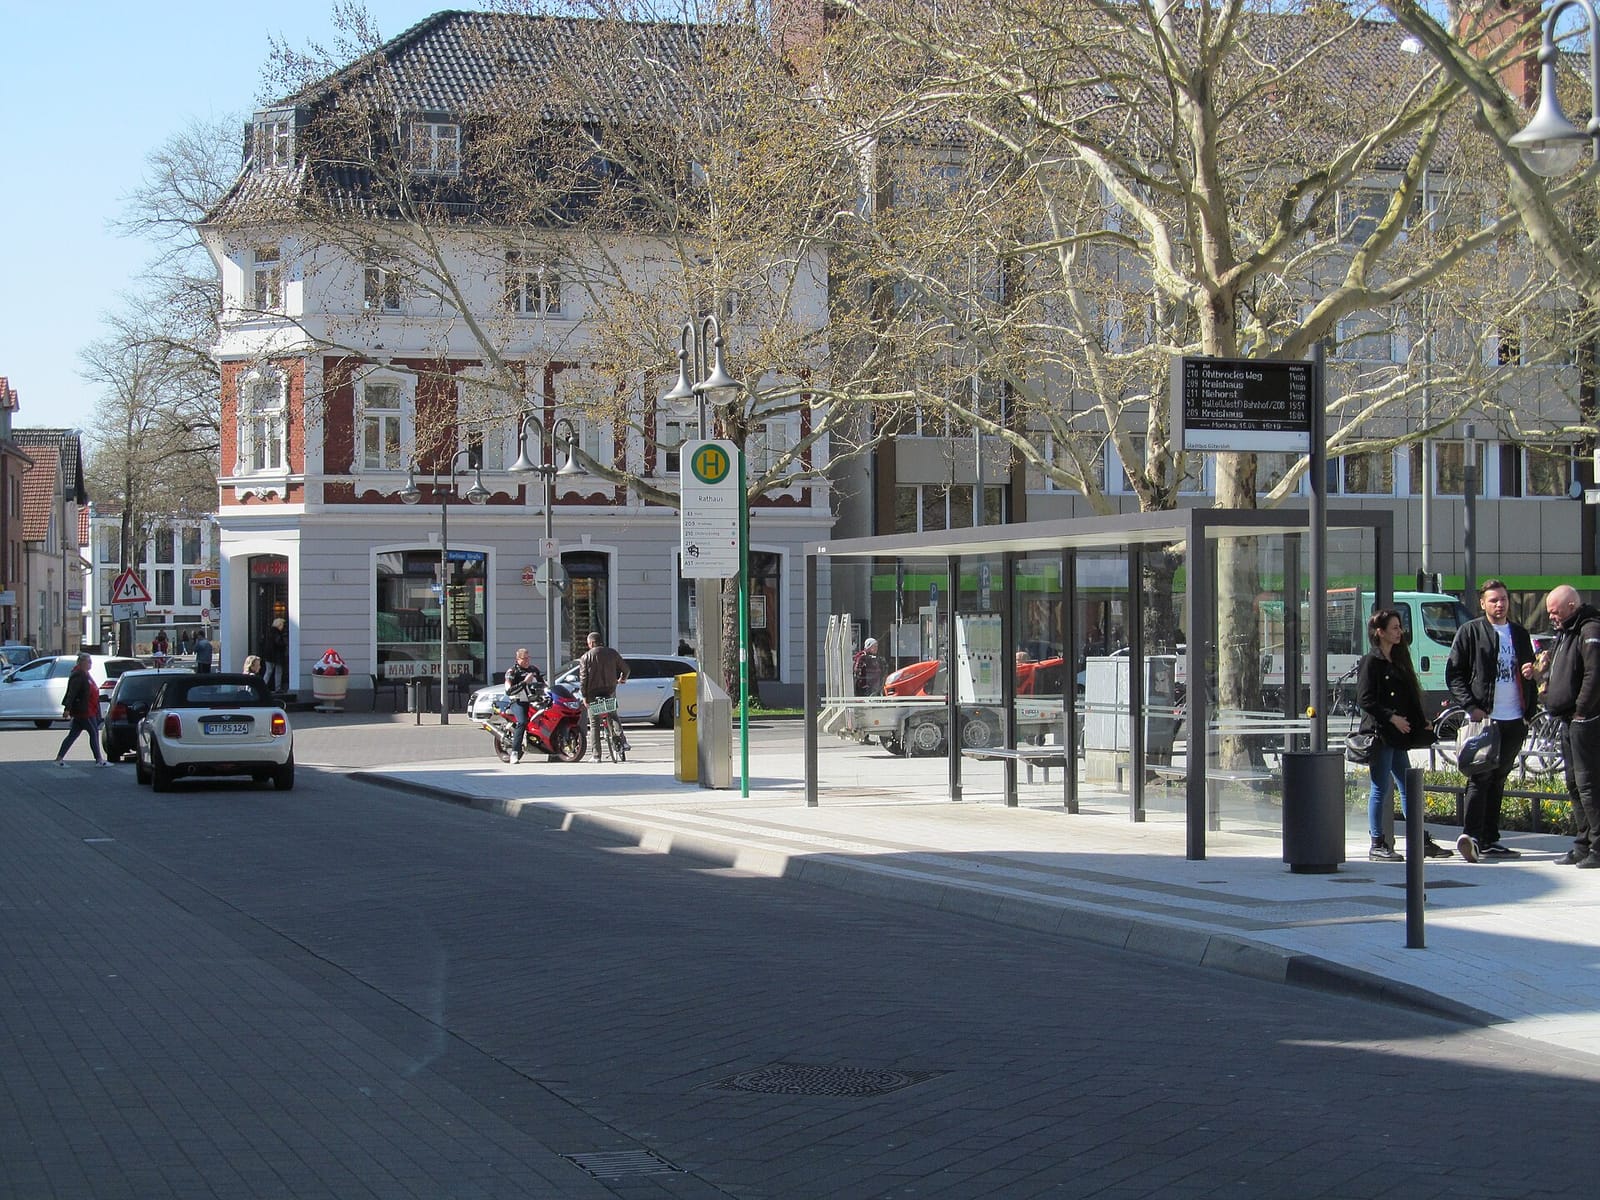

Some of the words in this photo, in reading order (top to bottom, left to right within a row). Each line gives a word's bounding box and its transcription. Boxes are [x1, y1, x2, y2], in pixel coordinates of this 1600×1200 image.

[1186, 369, 1199, 378] 210
[1202, 370, 1244, 379] Ohlbrocks
[1245, 371, 1263, 382] Weg
[1186, 379, 1199, 388] 209
[1202, 379, 1244, 389] Kreishaus
[1186, 389, 1198, 398] 211
[1186, 409, 1199, 417] 209
[1202, 409, 1244, 418] Kreishaus
[703, 453, 719, 476] H
